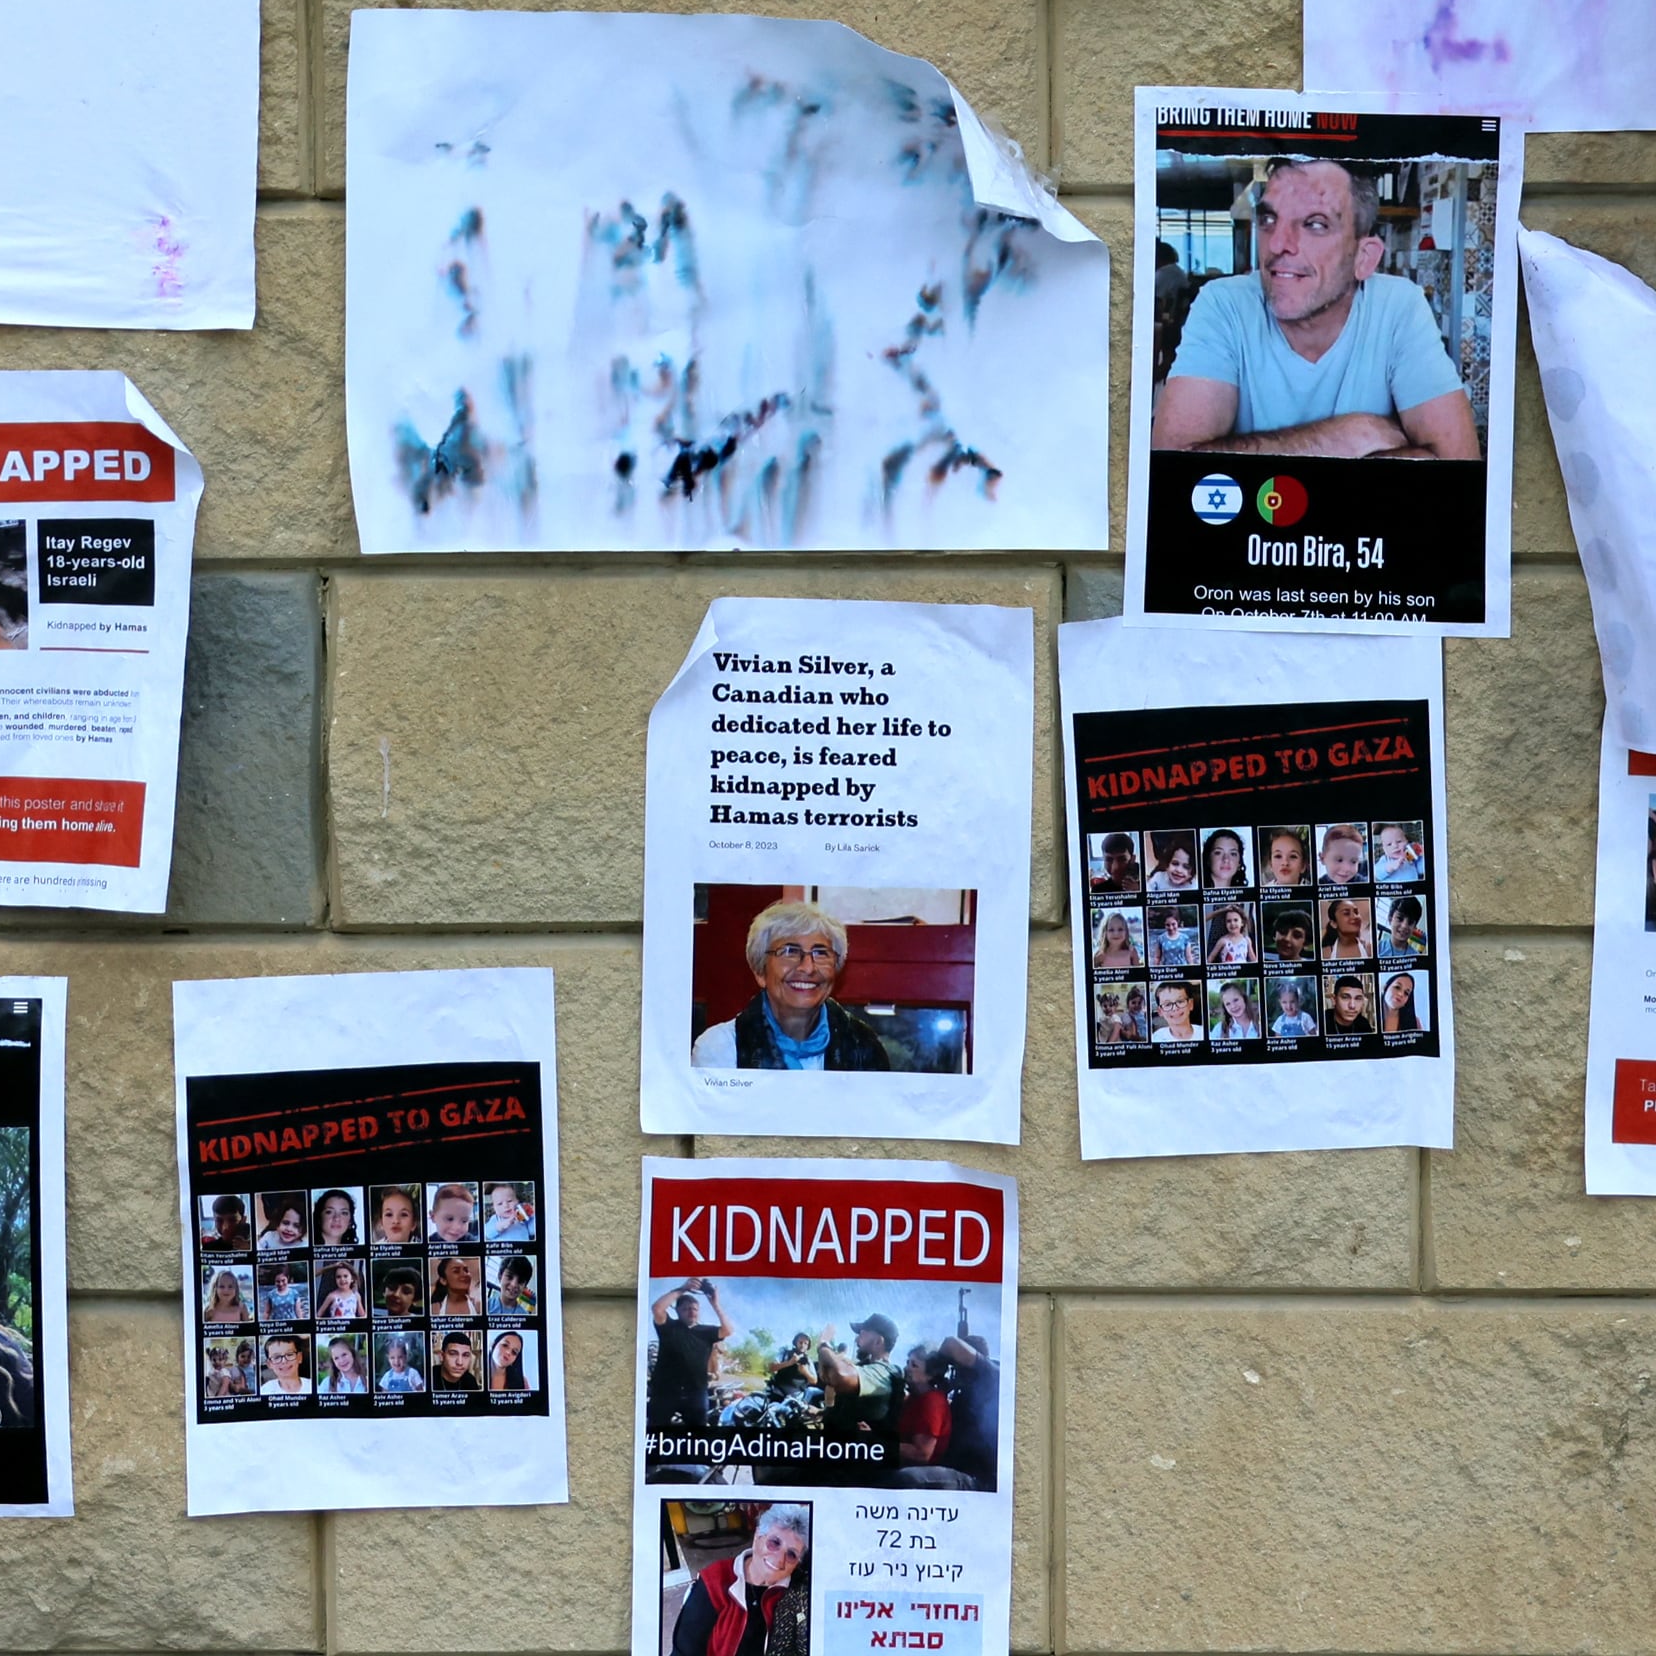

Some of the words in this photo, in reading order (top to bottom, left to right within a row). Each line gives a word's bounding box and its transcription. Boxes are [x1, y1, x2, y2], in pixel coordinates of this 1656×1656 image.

[46, 536, 75, 552] Itay
[81, 536, 131, 552] Regev
[1248, 534, 1297, 566] Oron
[1303, 535, 1350, 573] Bira,
[1357, 537, 1384, 569] 54
[47, 555, 145, 571] 18-years-old
[47, 573, 97, 587] Israeli
[1194, 585, 1233, 600] Oron
[1239, 590, 1271, 601] was
[1277, 587, 1305, 602] last
[1310, 592, 1348, 604] seen
[1354, 590, 1373, 608] by
[1378, 590, 1401, 606] his
[1406, 595, 1435, 607] son
[713, 652, 792, 673] Vivian
[798, 655, 874, 679] Silver,
[880, 663, 896, 676] a
[712, 683, 834, 705] Canadian
[839, 687, 889, 706] who
[711, 714, 831, 735] dedicated
[836, 716, 877, 736] her
[882, 717, 922, 736] life
[928, 720, 951, 737] to
[710, 750, 787, 769] peace,
[793, 746, 813, 765] is
[819, 746, 897, 766] feared
[1087, 754, 1267, 799] KIDNAPPED
[1275, 748, 1318, 773] TO
[1328, 736, 1415, 766] GAZA
[710, 774, 840, 801] kidnapped
[845, 777, 876, 802] by
[709, 805, 799, 825] Hamas
[804, 808, 918, 827] terrorists
[709, 840, 744, 849] October
[755, 841, 778, 850] 2023
[825, 843, 836, 853] By
[854, 844, 880, 852] Sarick
[198, 1118, 379, 1163] KIDNAPPED
[387, 1108, 430, 1133] TO
[439, 1096, 526, 1128] GAZA
[672, 1205, 990, 1267] KIDNAPPED
[644, 1432, 886, 1464] #bringAdinaHome
